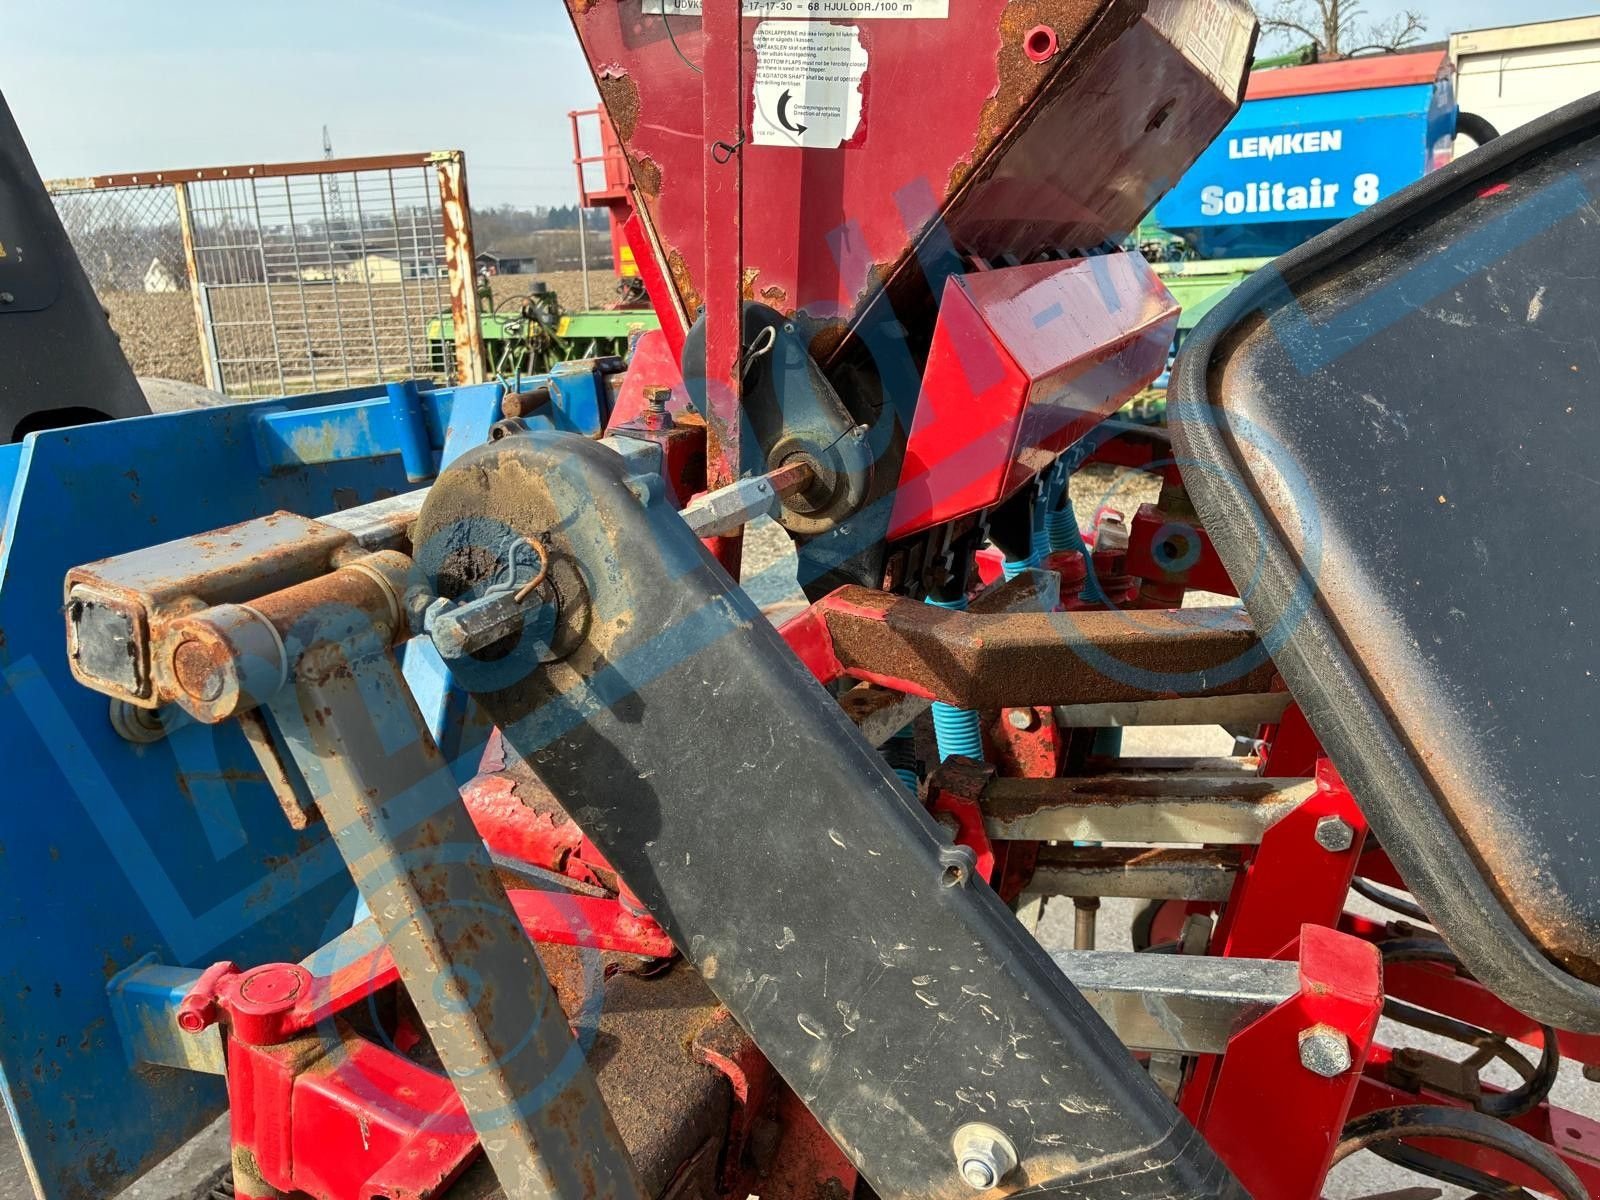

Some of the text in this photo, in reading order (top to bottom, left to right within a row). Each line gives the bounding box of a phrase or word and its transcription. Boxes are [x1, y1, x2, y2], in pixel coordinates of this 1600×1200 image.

[808, 2, 819, 10] 68
[824, 2, 898, 11] HJULODR./100
[903, 3, 912, 11] m
[820, 111, 841, 119] rotation
[1228, 129, 1342, 161] LEMKEN
[1200, 172, 1380, 216] Solitair 8
